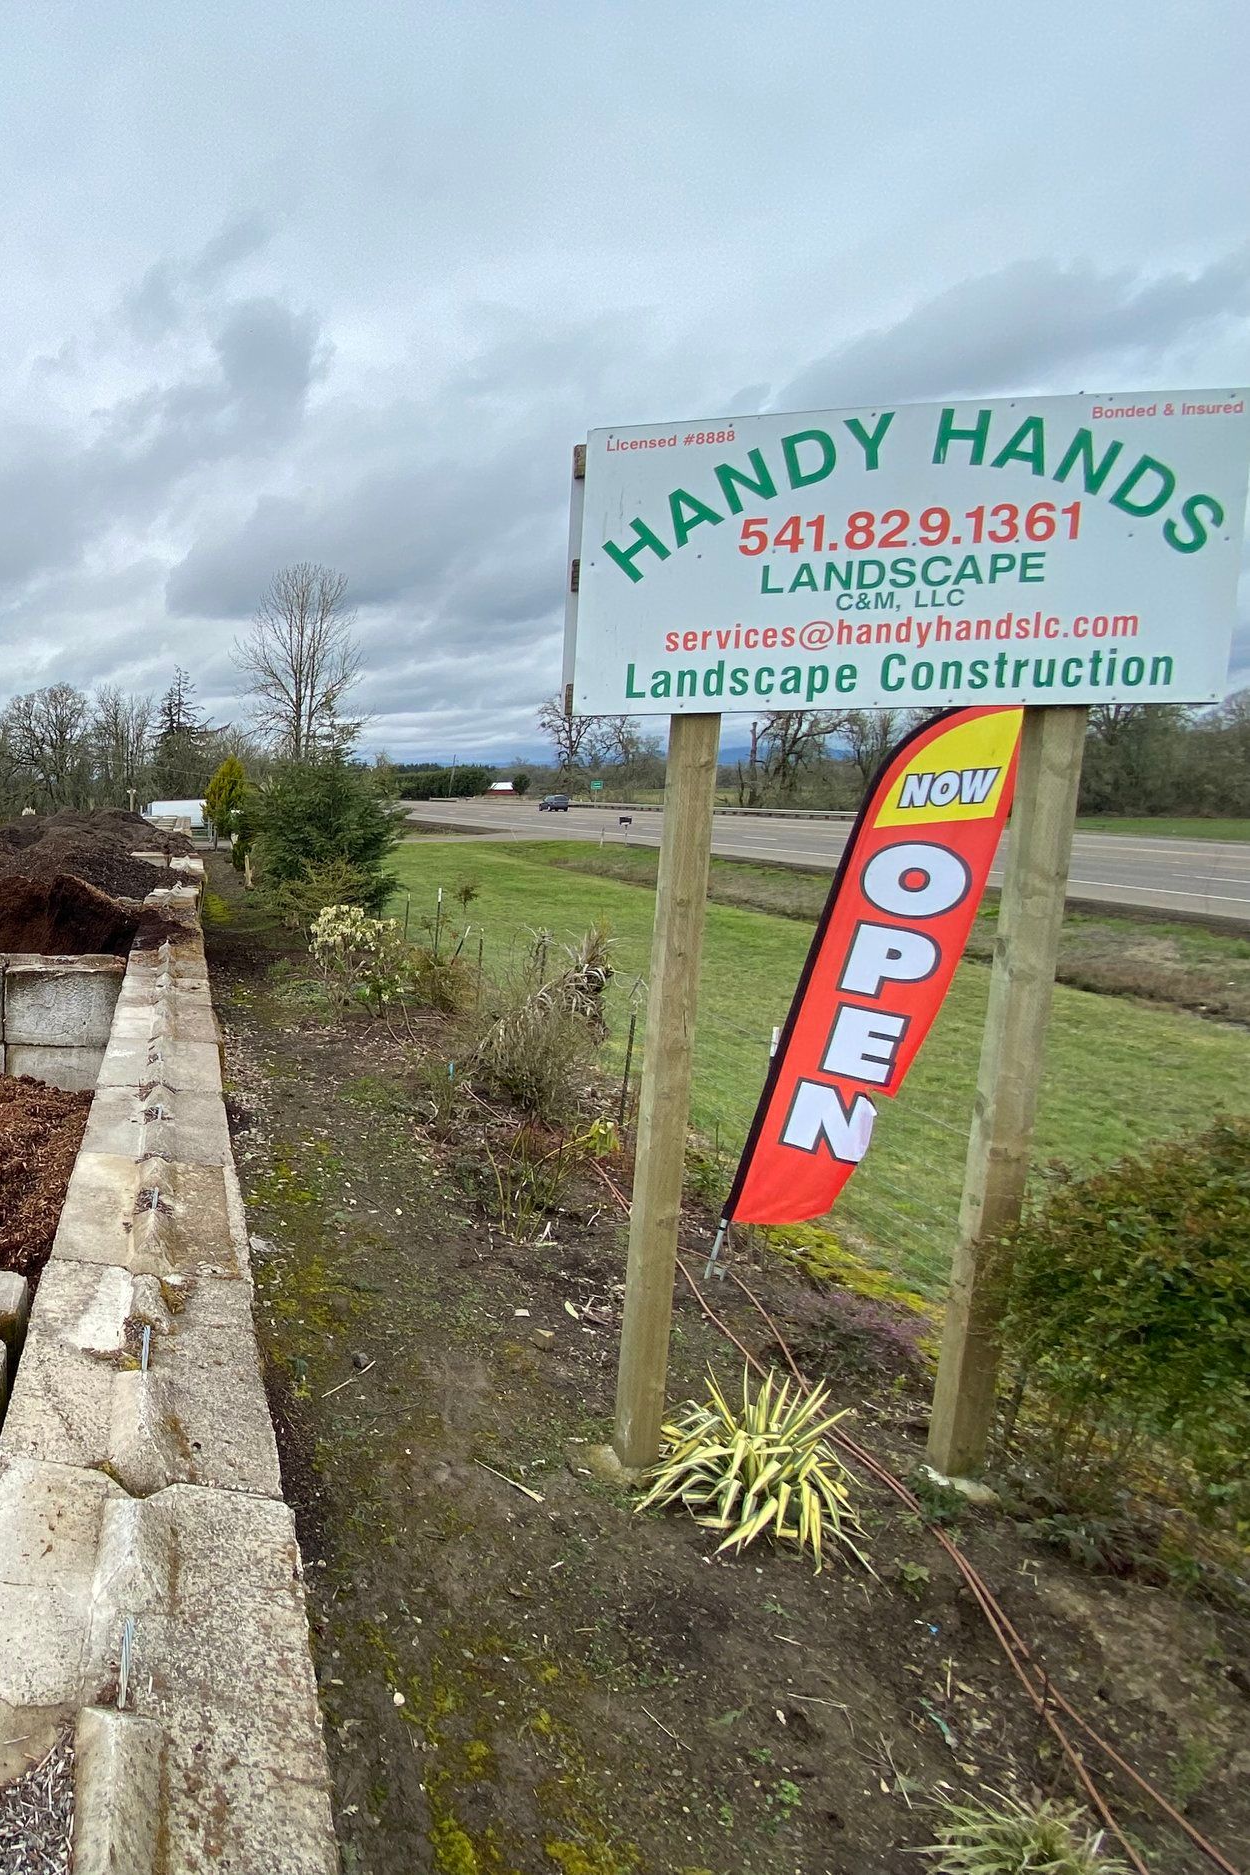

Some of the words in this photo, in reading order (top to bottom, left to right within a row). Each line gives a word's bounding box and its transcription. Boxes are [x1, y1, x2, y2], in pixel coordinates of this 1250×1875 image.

[1092, 403, 1156, 419] Bonded
[1163, 403, 1174, 416] &
[1182, 400, 1244, 415] Insured
[606, 434, 678, 452] Licensed
[683, 430, 736, 446] #8888
[602, 412, 896, 583] HANDY
[932, 408, 1225, 554] HANDS
[739, 501, 1082, 556] 541.829.1361
[760, 552, 1046, 594] LANDSCAPE
[836, 591, 901, 612] C&M,
[914, 589, 966, 608] LLC
[665, 612, 1139, 652] services@handyhandslc.com
[625, 660, 858, 702] Landscape
[880, 648, 1174, 692] Construction
[896, 767, 1002, 809] NOW
[780, 840, 972, 1165] OPEN
